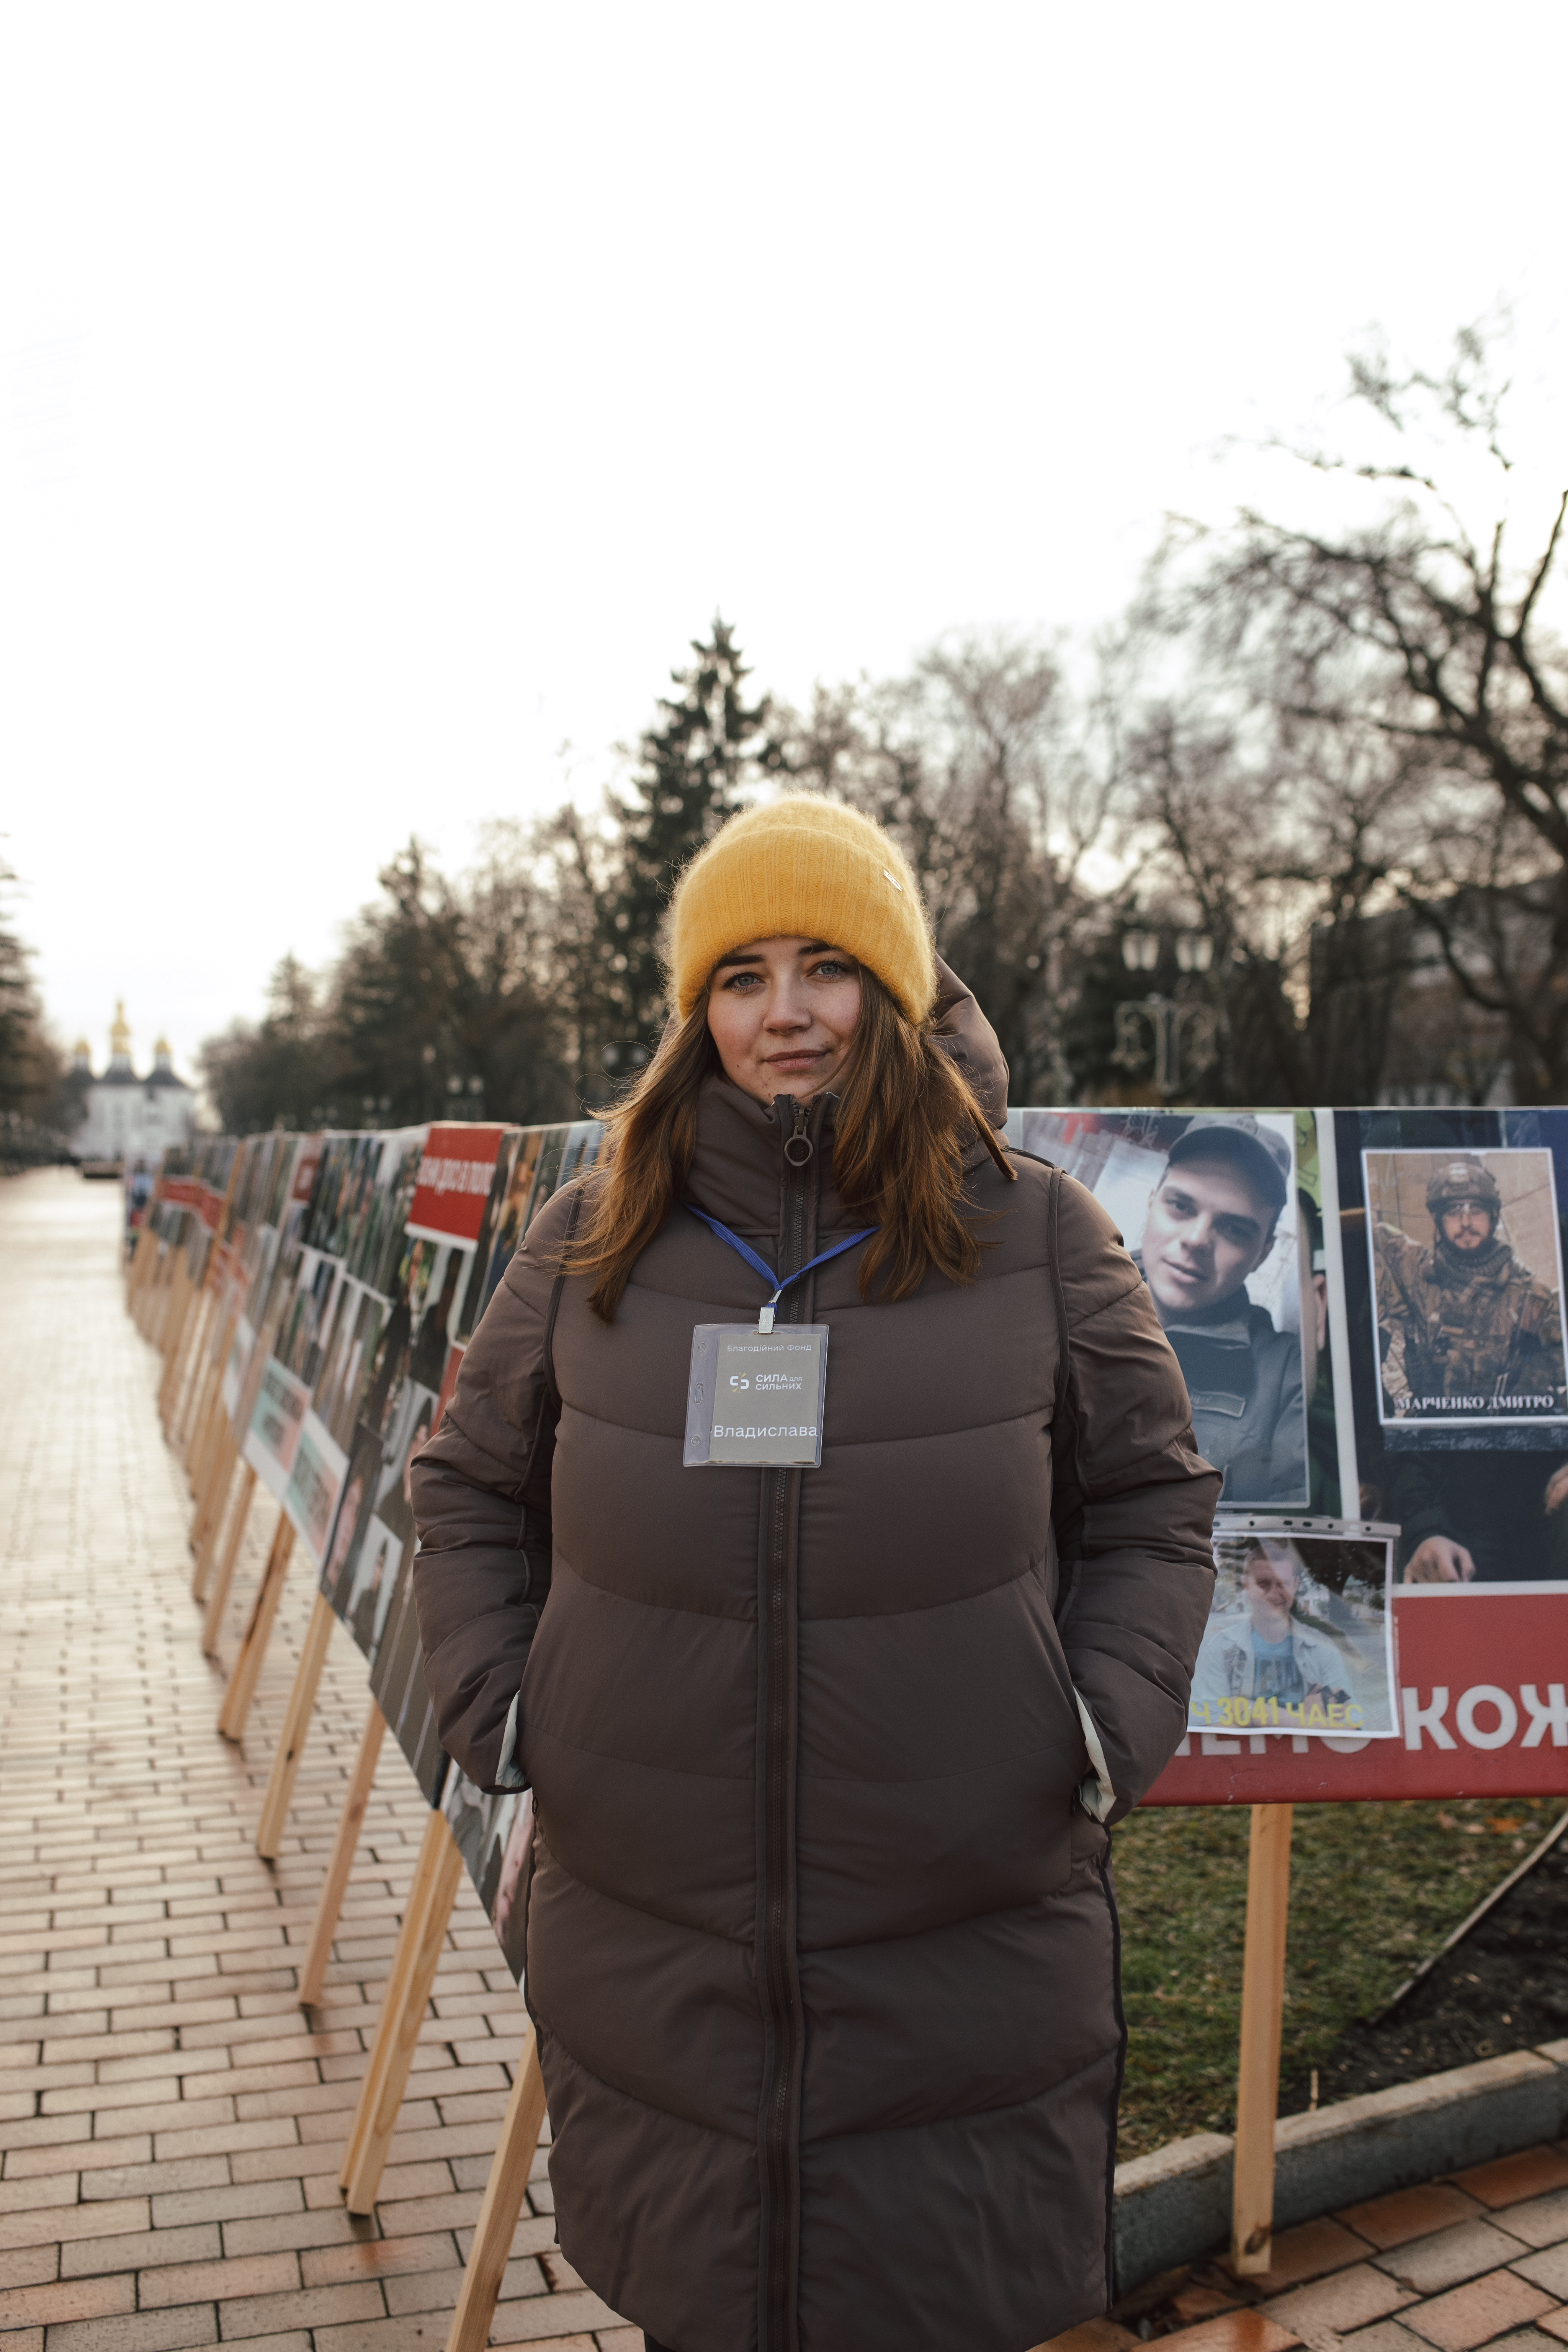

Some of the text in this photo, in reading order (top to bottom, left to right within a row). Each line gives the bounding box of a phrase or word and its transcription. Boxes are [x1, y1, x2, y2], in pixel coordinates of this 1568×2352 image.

[727, 1344, 784, 1352] Благодійний
[756, 1374, 788, 1383] СИЛА
[1397, 1394, 1555, 1410] МАРЧЕНКО ДМИТРО
[714, 1425, 818, 1438] Владислава
[1285, 1702, 1364, 1728] ЧАЕС
